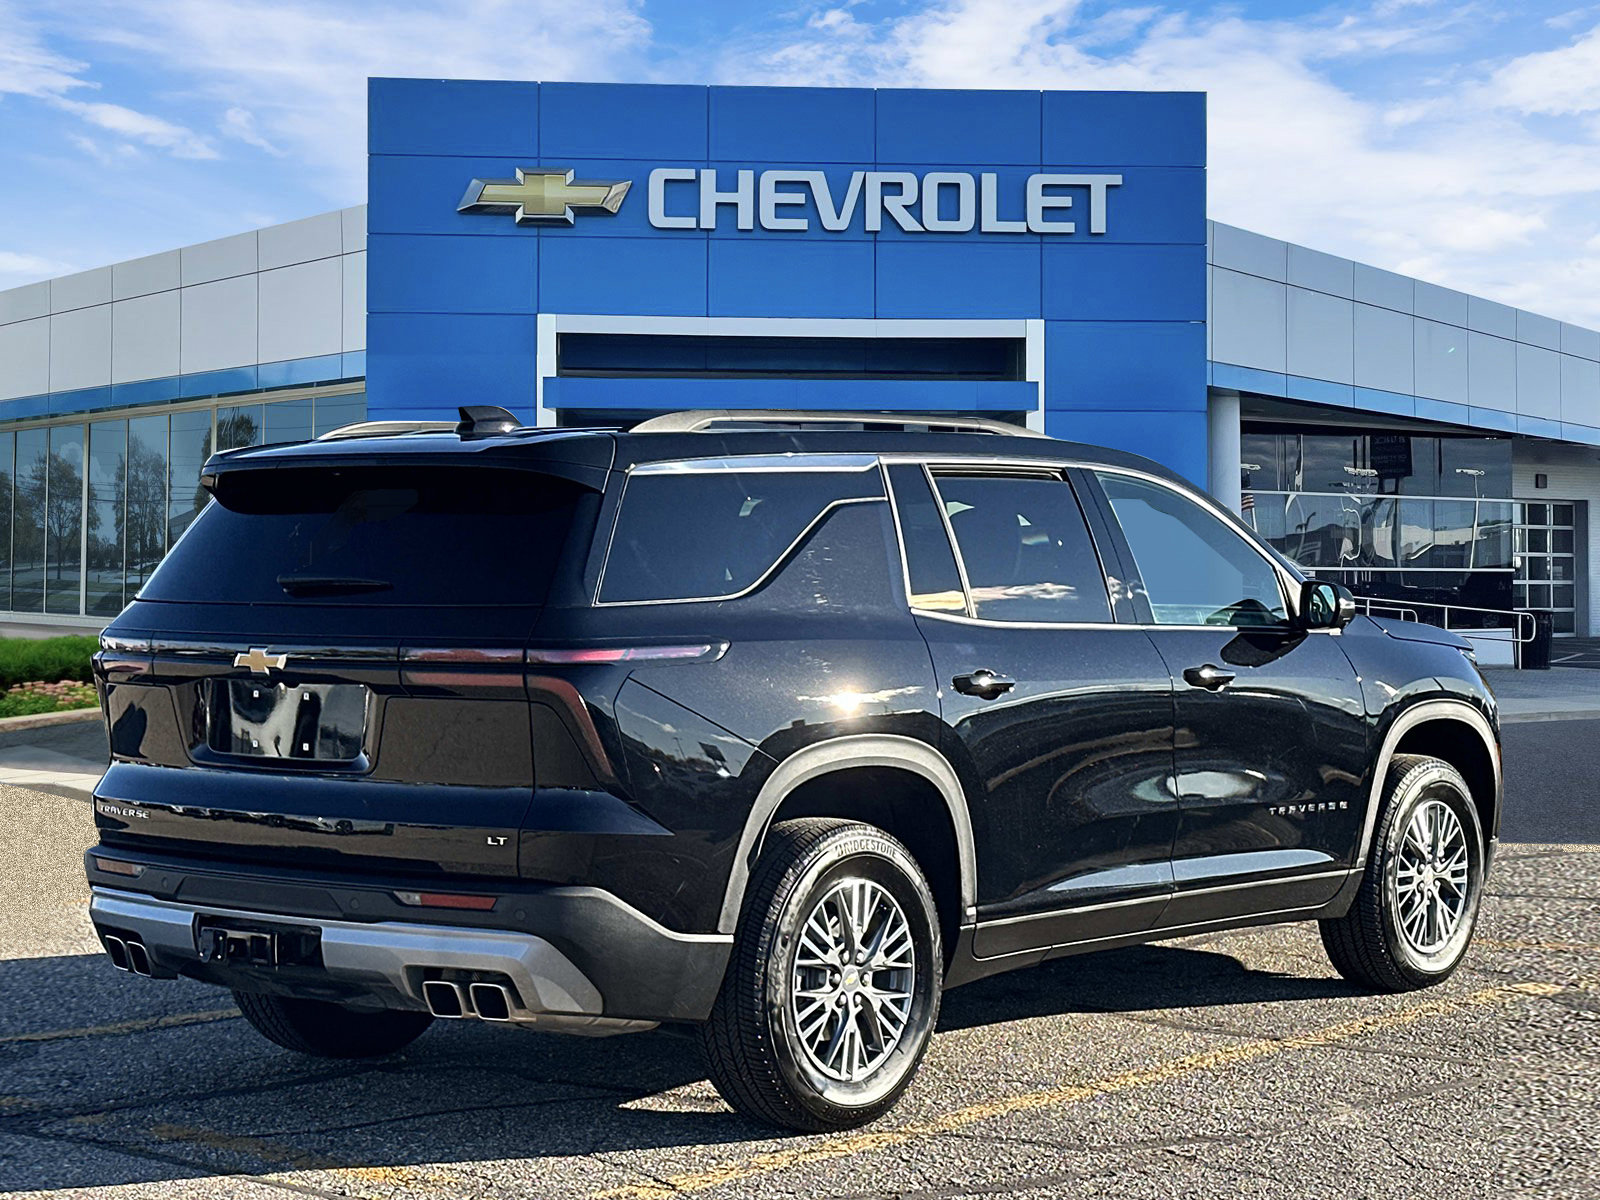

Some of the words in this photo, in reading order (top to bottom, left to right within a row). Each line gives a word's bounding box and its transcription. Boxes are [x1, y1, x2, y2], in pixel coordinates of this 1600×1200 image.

[648, 167, 1123, 233] CHEVROLET
[100, 804, 149, 819] TRAVERSE
[1269, 801, 1348, 815] TRAVERSE
[487, 836, 508, 846] LT
[835, 839, 897, 859] BRIDGESTONE
